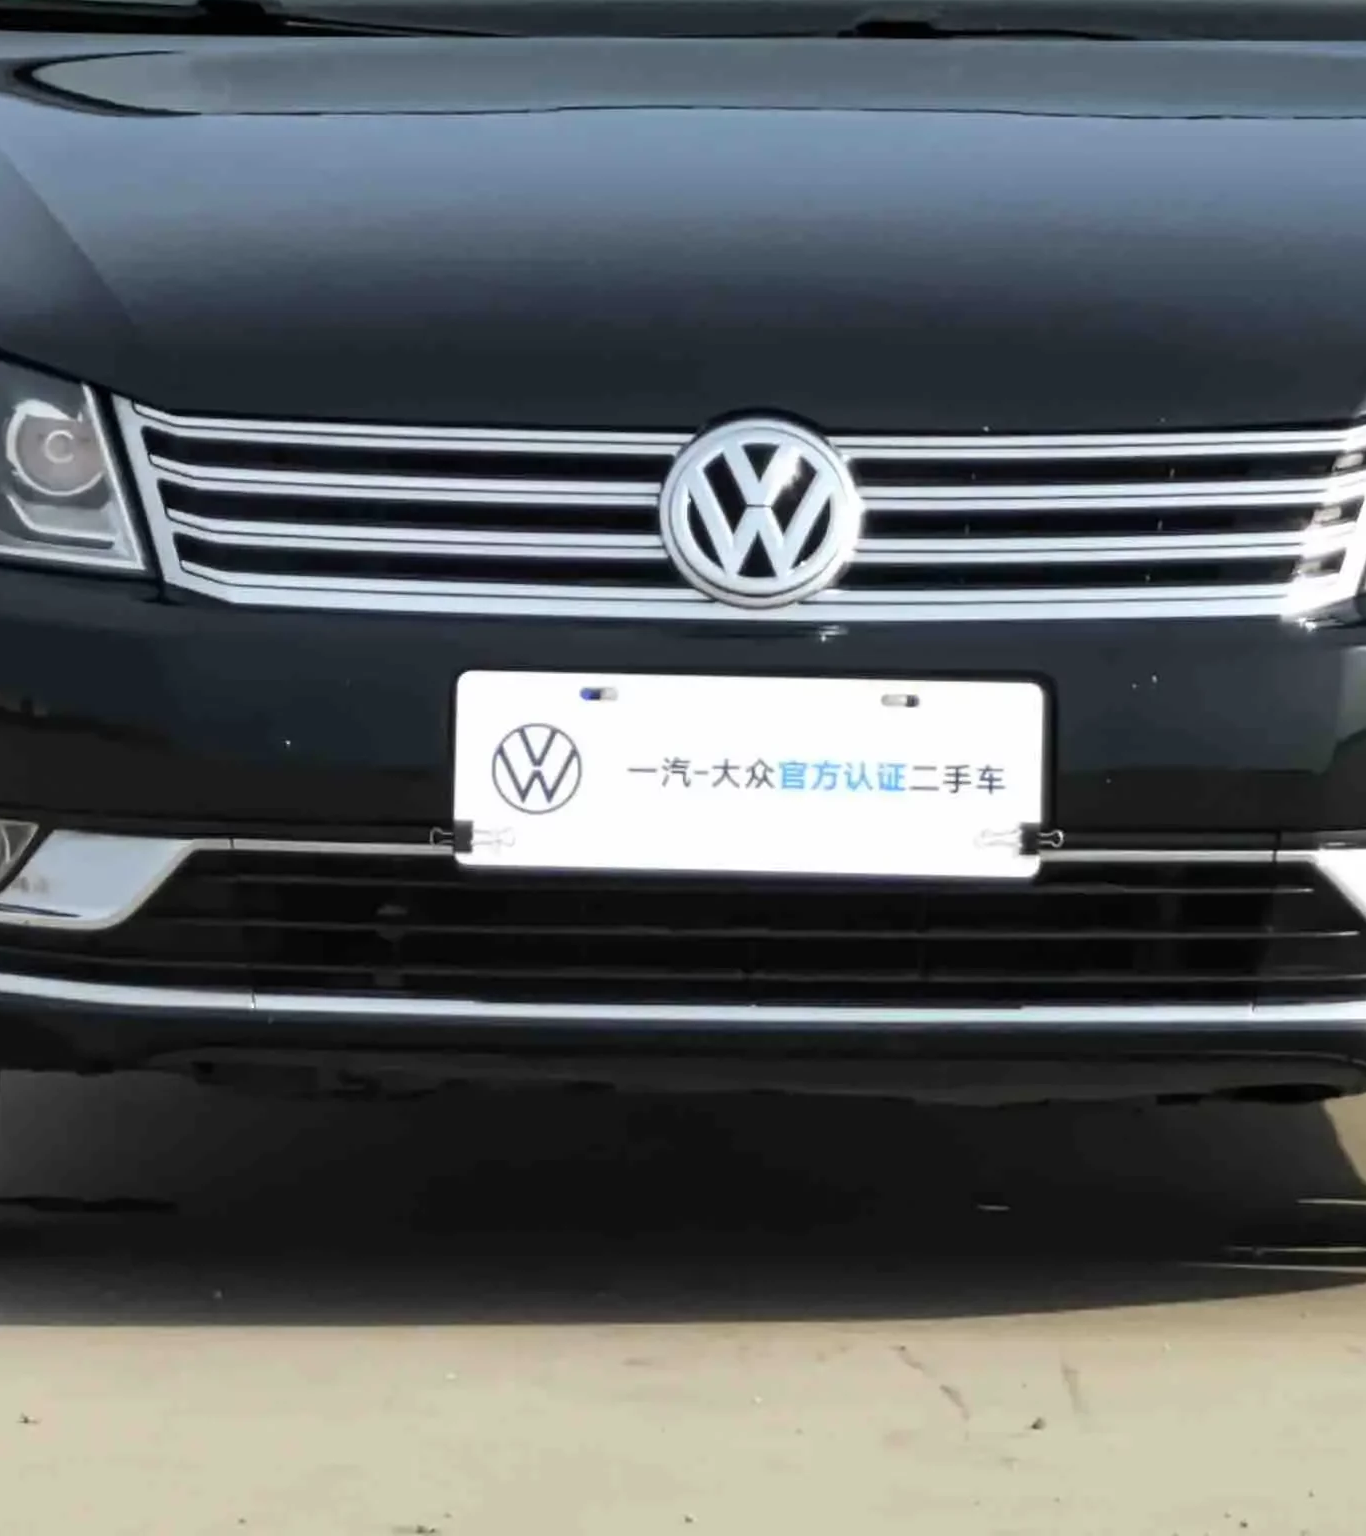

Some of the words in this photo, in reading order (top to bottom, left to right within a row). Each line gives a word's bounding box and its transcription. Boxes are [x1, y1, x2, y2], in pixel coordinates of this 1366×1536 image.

[626, 756, 1007, 795] 一汽-大众官方认证二手车
